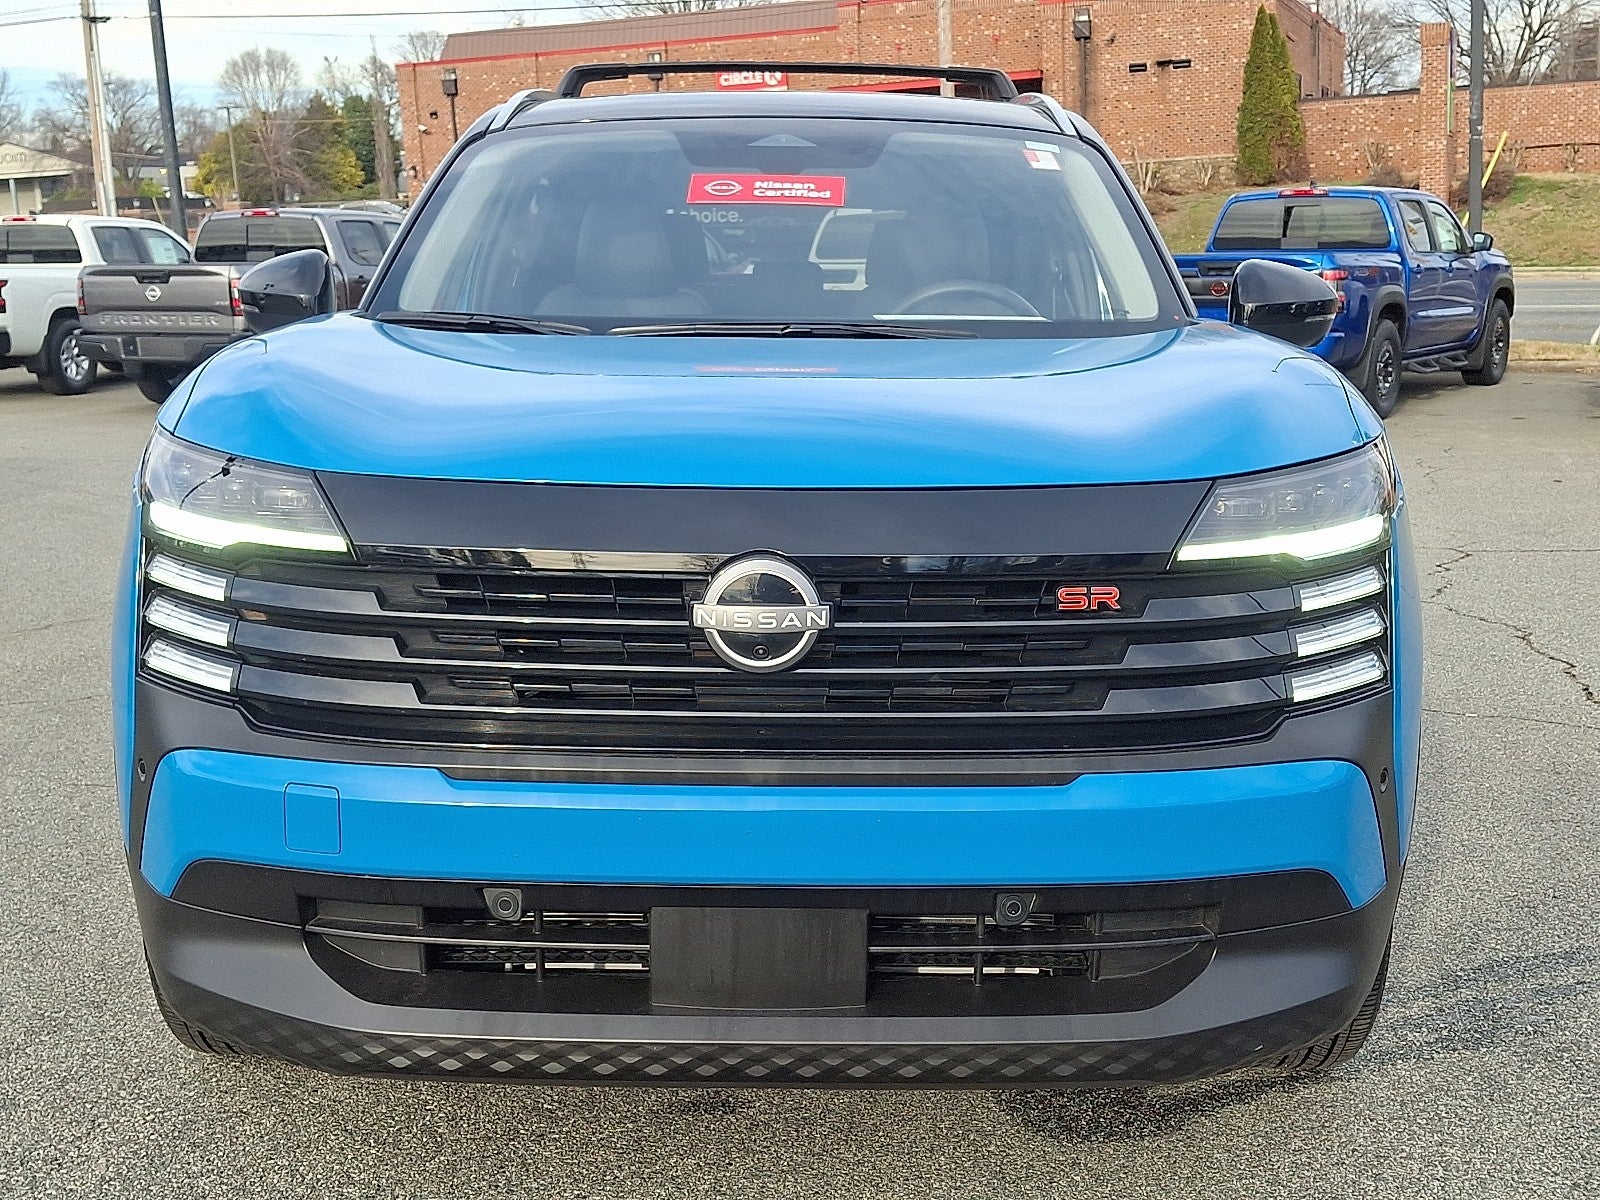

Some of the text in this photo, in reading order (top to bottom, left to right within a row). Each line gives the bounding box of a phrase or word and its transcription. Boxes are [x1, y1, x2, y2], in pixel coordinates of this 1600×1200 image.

[719, 71, 764, 86] CIRCLE
[753, 180, 831, 199] Nissan Certified
[680, 207, 744, 223] hoice.
[100, 314, 220, 326] FRONTIER
[1057, 586, 1121, 610] SR
[696, 608, 827, 629] NISSAN
